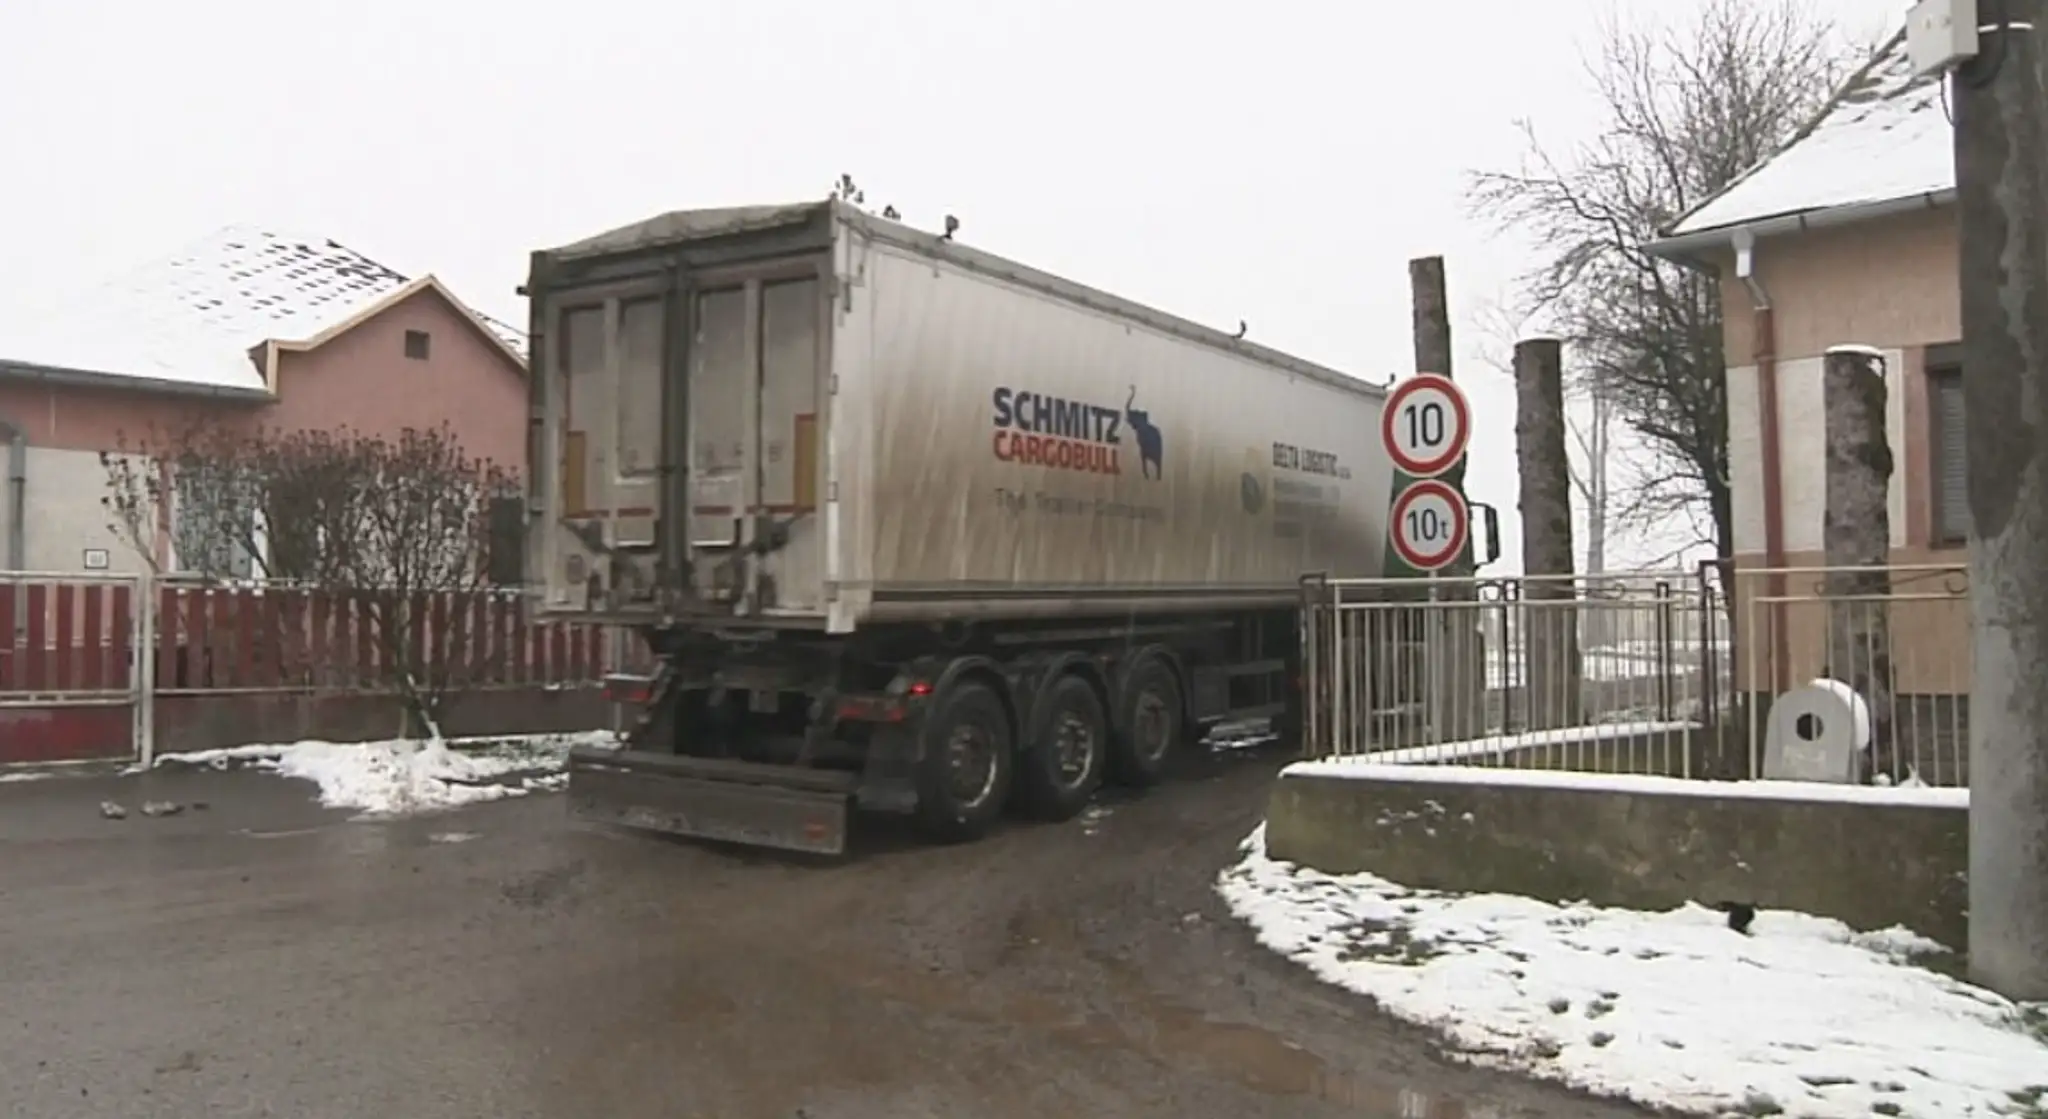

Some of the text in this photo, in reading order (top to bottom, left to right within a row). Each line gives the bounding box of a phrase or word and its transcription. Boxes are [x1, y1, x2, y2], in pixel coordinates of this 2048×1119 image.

[993, 387, 1121, 444] SCHMITZ
[1405, 402, 1444, 448] 10
[993, 430, 1121, 475] CARGOBULL
